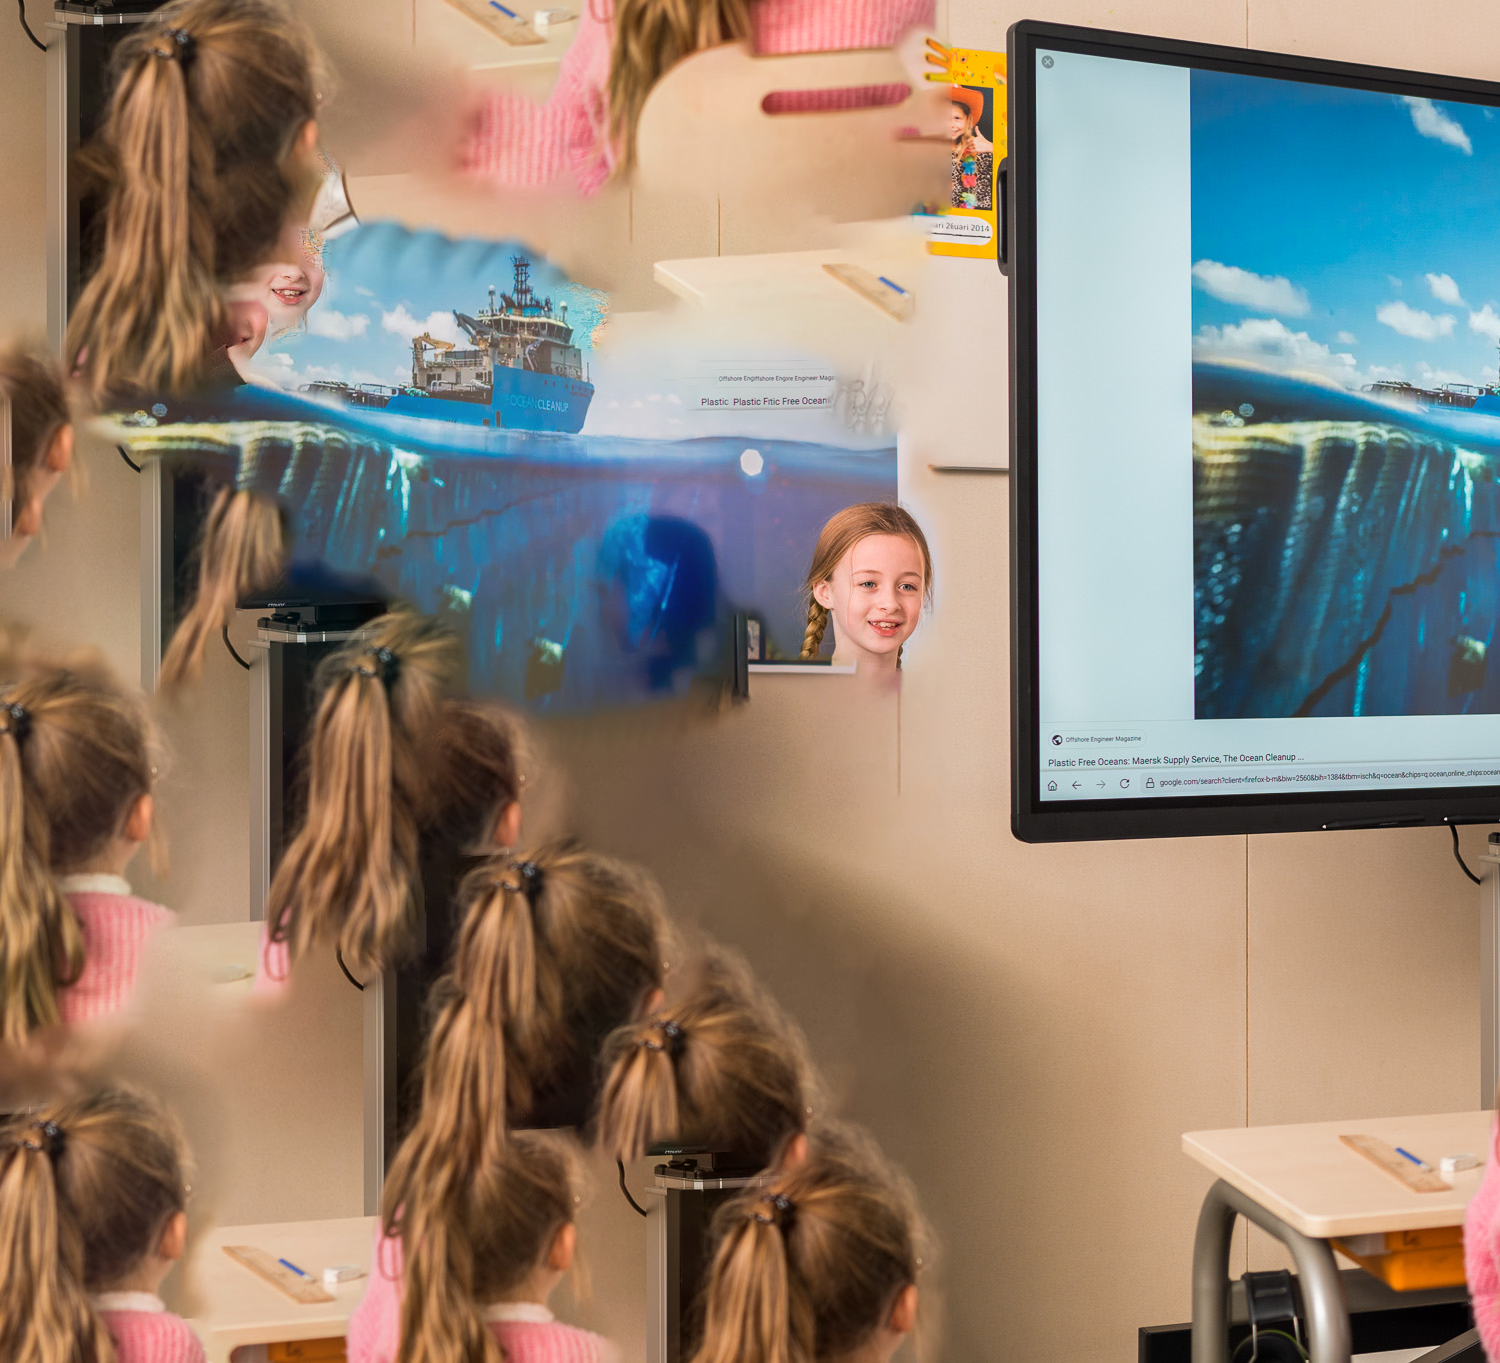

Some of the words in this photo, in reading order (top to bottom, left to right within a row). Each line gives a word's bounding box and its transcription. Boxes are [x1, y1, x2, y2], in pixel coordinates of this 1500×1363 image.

[701, 398, 729, 406] Plastic
[733, 397, 761, 406] Plastic
[782, 397, 800, 405] Free
[1115, 735, 1142, 743] Magazine
[1048, 759, 1076, 767] Plastic
[1078, 758, 1096, 766] Free
[1097, 757, 1130, 766] Oceans:
[1132, 756, 1161, 765] Maersk
[1163, 755, 1189, 766] Supply
[1191, 755, 1222, 764] Service,
[1223, 754, 1238, 763] The
[1239, 753, 1264, 763] Ocean
[1265, 753, 1296, 763] Cleanup
